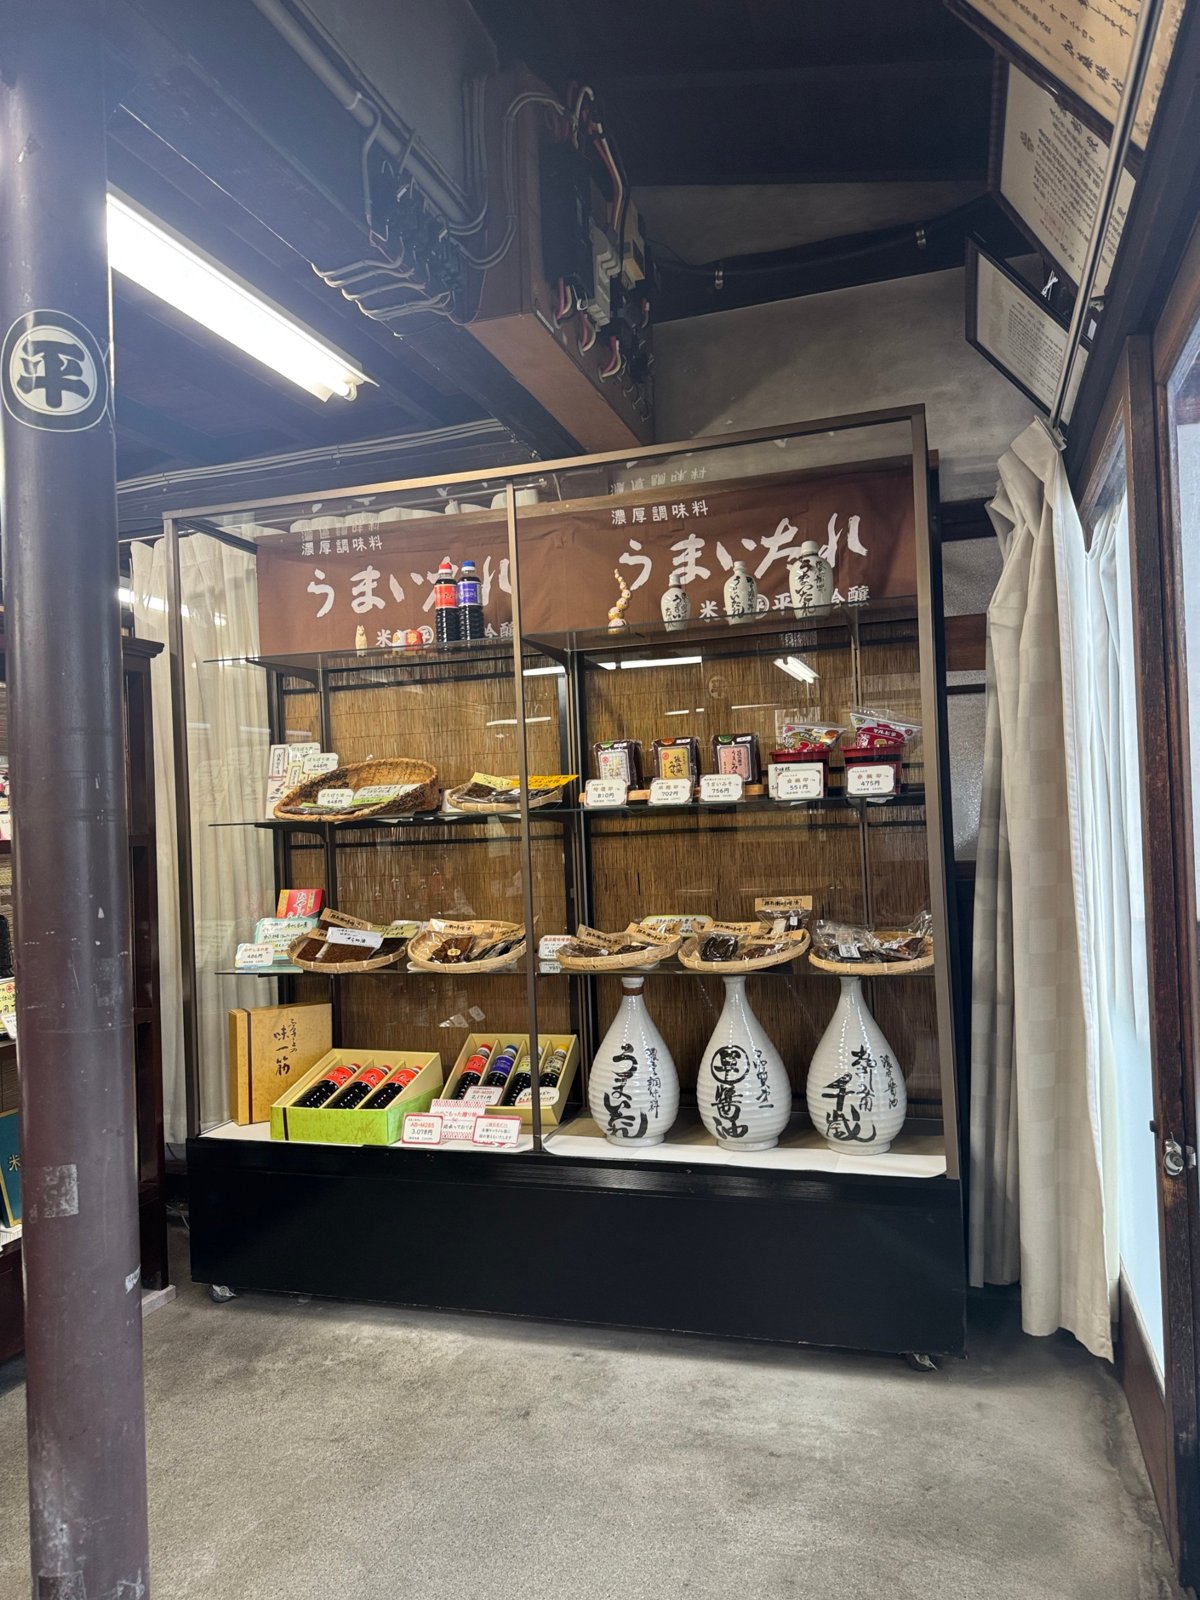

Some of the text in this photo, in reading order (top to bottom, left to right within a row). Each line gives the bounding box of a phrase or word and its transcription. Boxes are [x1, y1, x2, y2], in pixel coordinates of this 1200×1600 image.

[611, 500, 708, 525] 濃厚調味料
[302, 535, 383, 556] 濃厚調味料
[618, 512, 869, 591] うまいたれ
[273, 1025, 290, 1076] 味一筋
[604, 1043, 648, 1138] うまいたれ
[822, 1072, 877, 1143] 千歳
